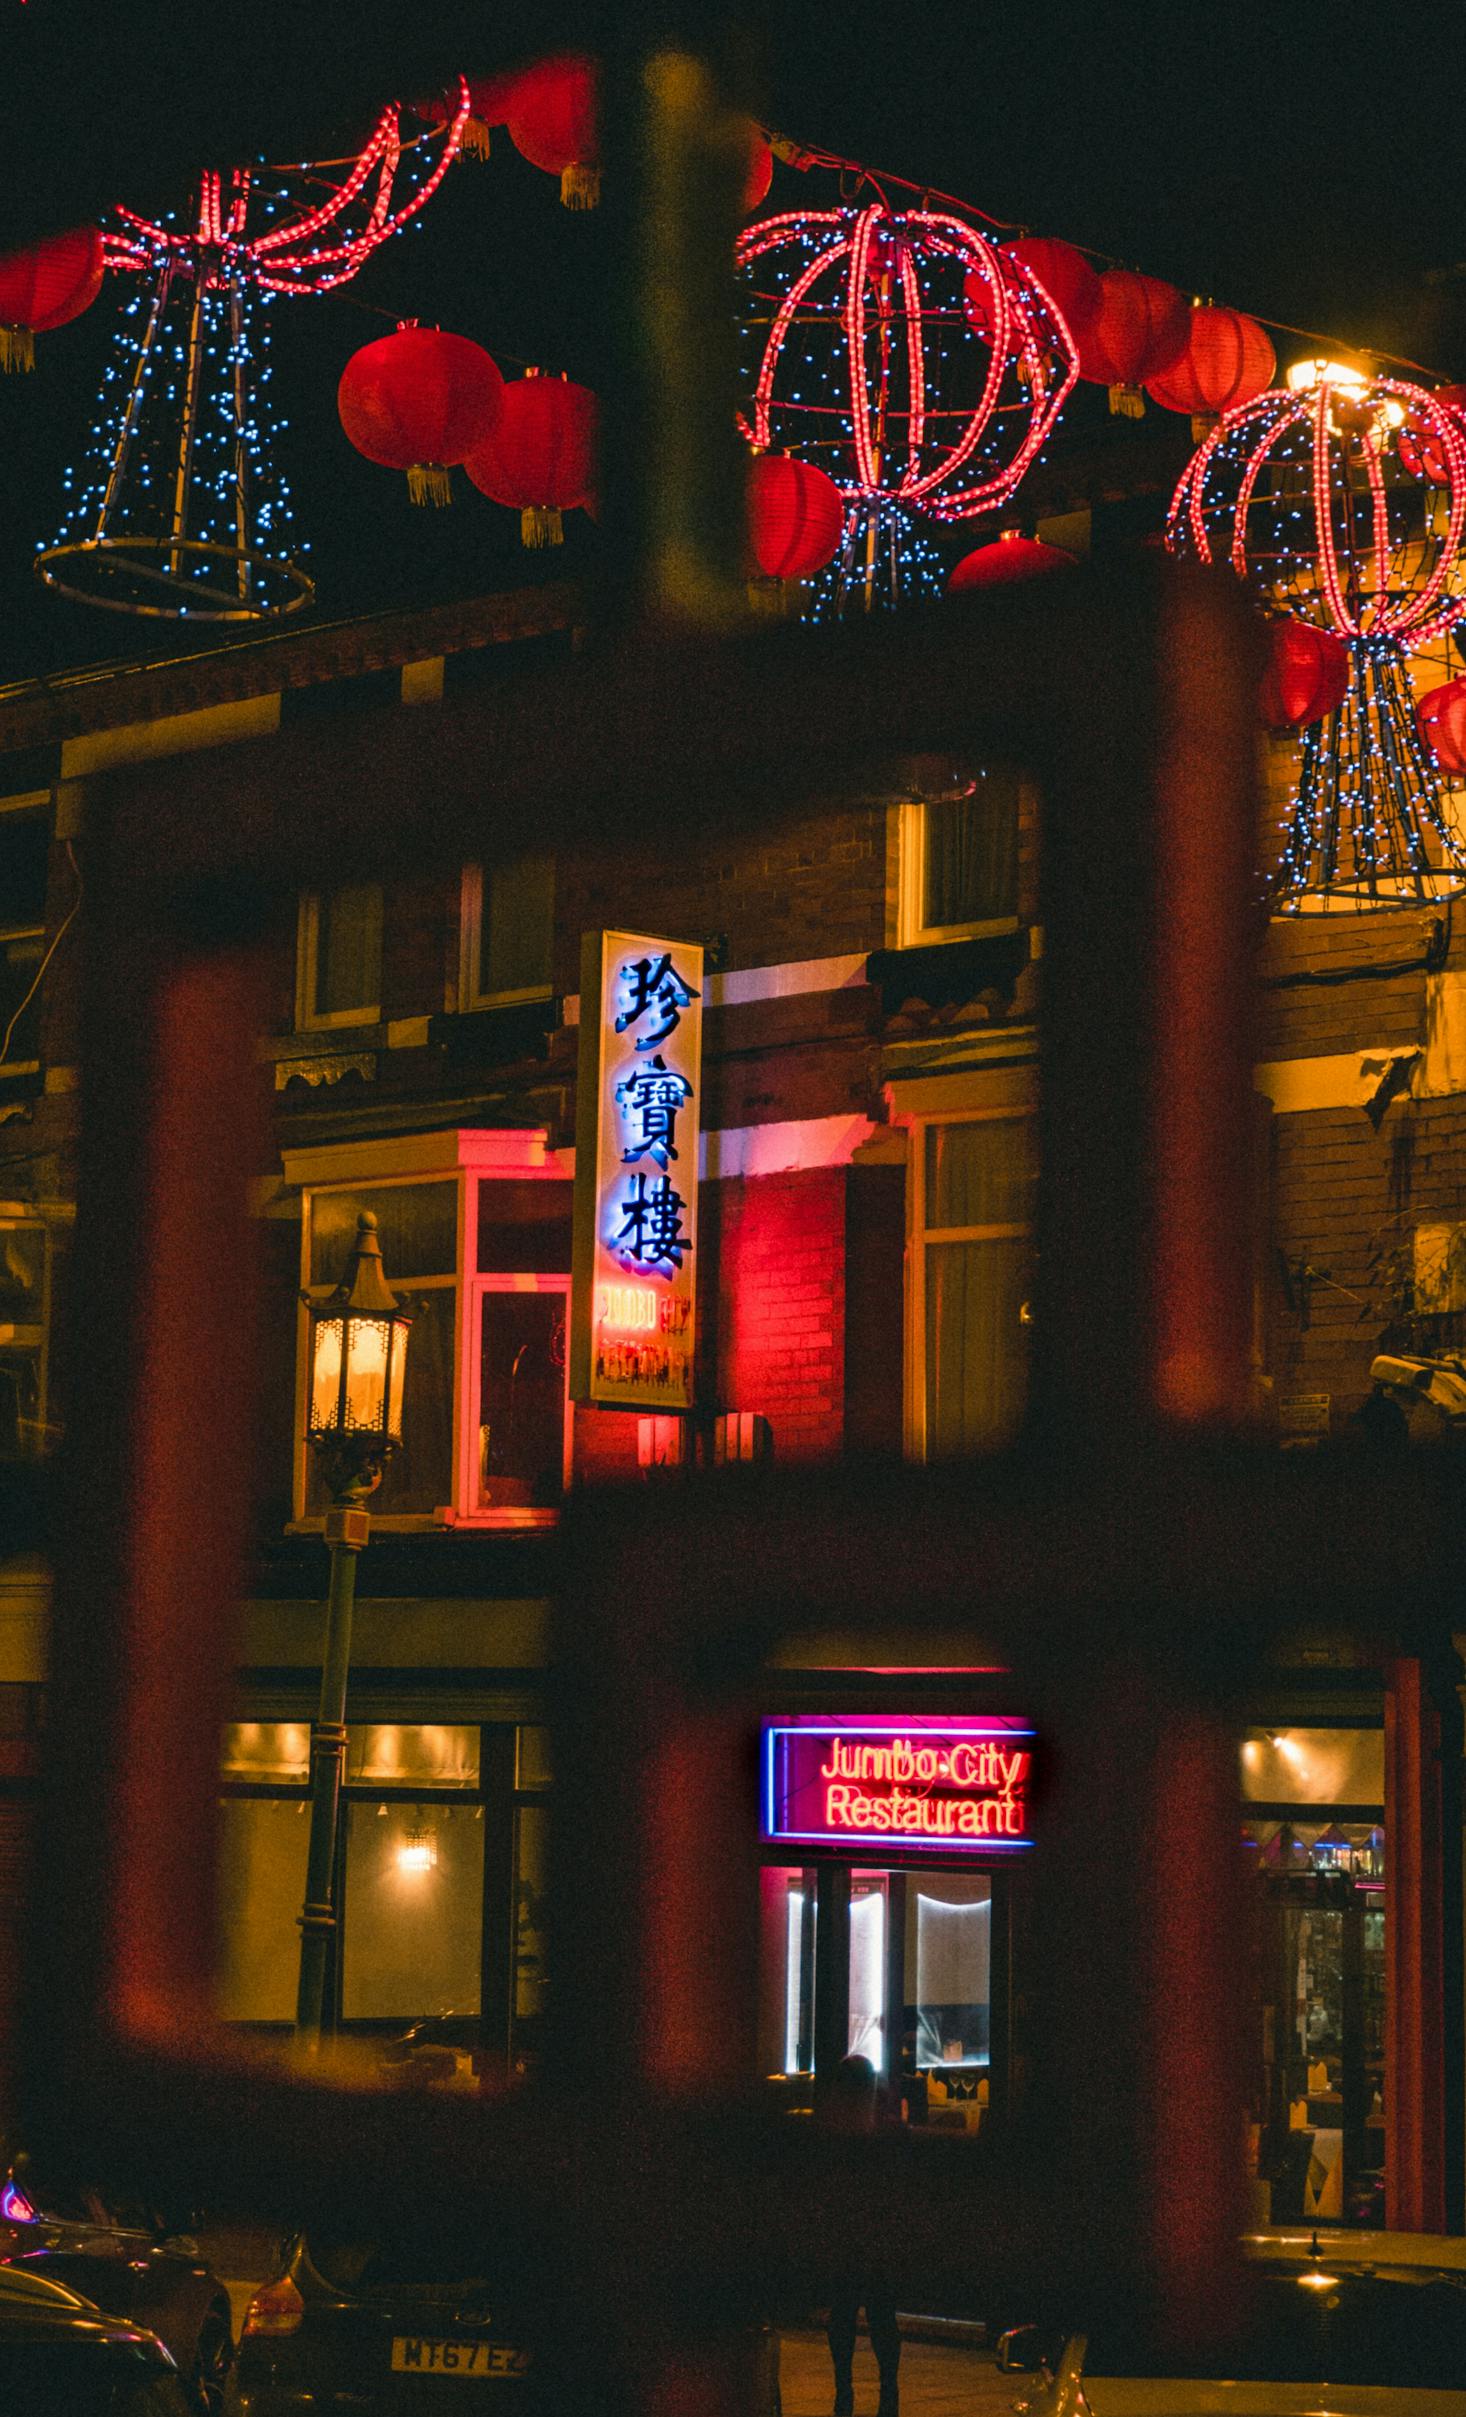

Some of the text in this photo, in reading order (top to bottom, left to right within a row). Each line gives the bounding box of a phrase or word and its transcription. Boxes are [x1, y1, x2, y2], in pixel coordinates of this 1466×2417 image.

[615, 953, 701, 1281] 珍寶樓
[821, 1737, 1023, 1795] Jumbo City
[826, 1784, 1021, 1834] Restaurant
